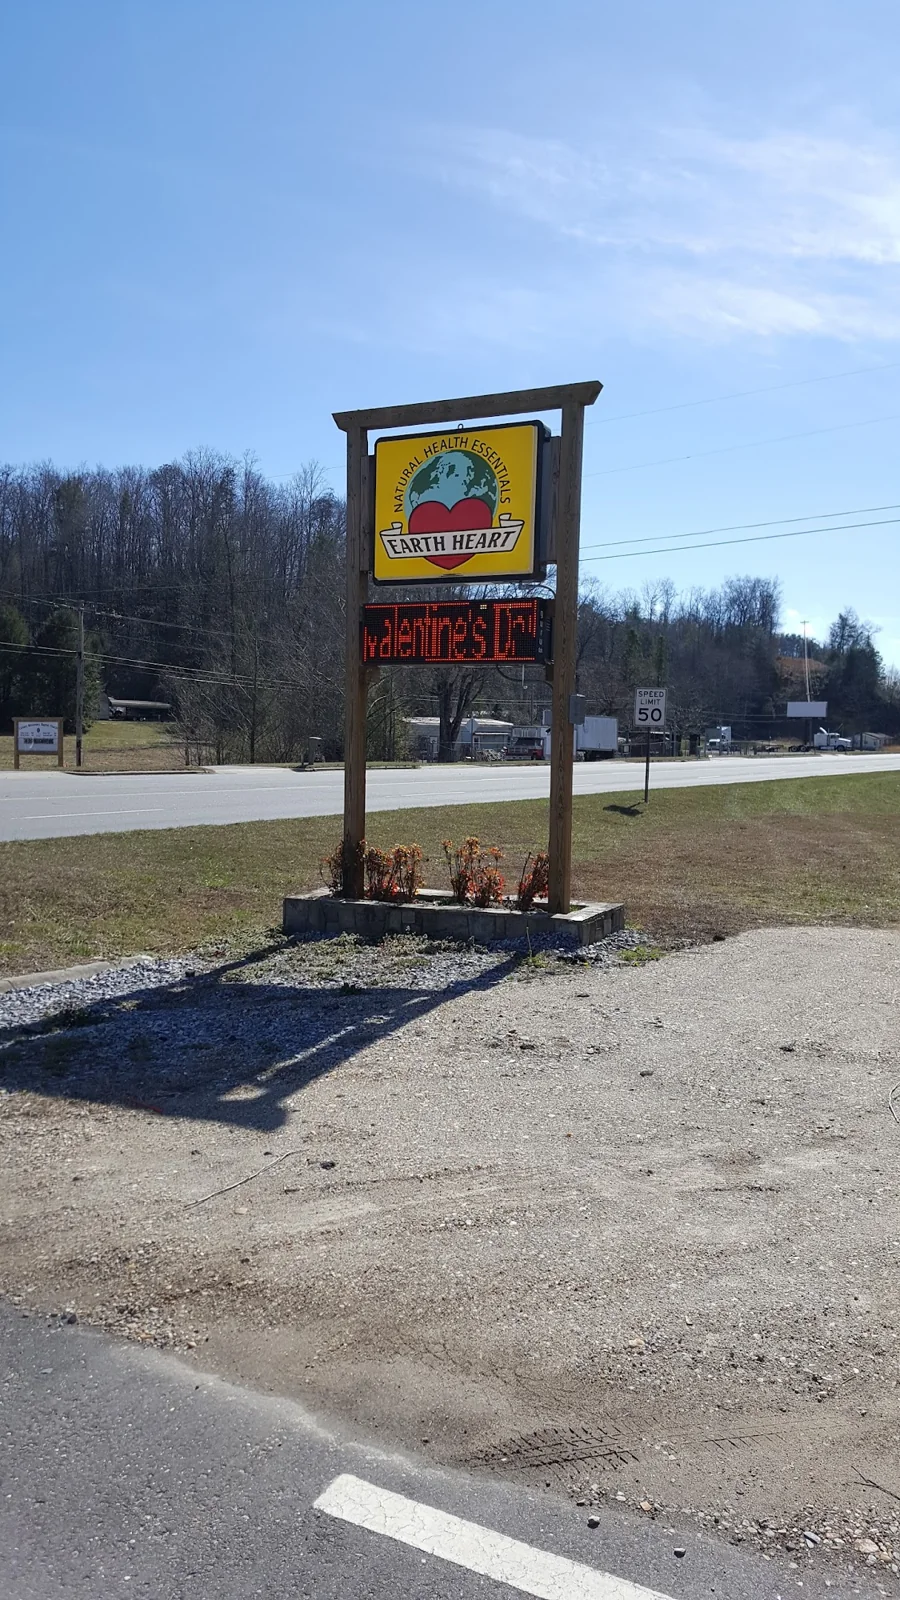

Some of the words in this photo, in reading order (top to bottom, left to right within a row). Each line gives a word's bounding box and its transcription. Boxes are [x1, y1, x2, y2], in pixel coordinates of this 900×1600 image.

[393, 456, 423, 513] NATURAL
[423, 436, 469, 459] HEALTH
[471, 439, 511, 504] ESSENTIALS
[386, 535, 446, 555] EARTH
[451, 530, 516, 551] HEART
[638, 707, 662, 722] 50
